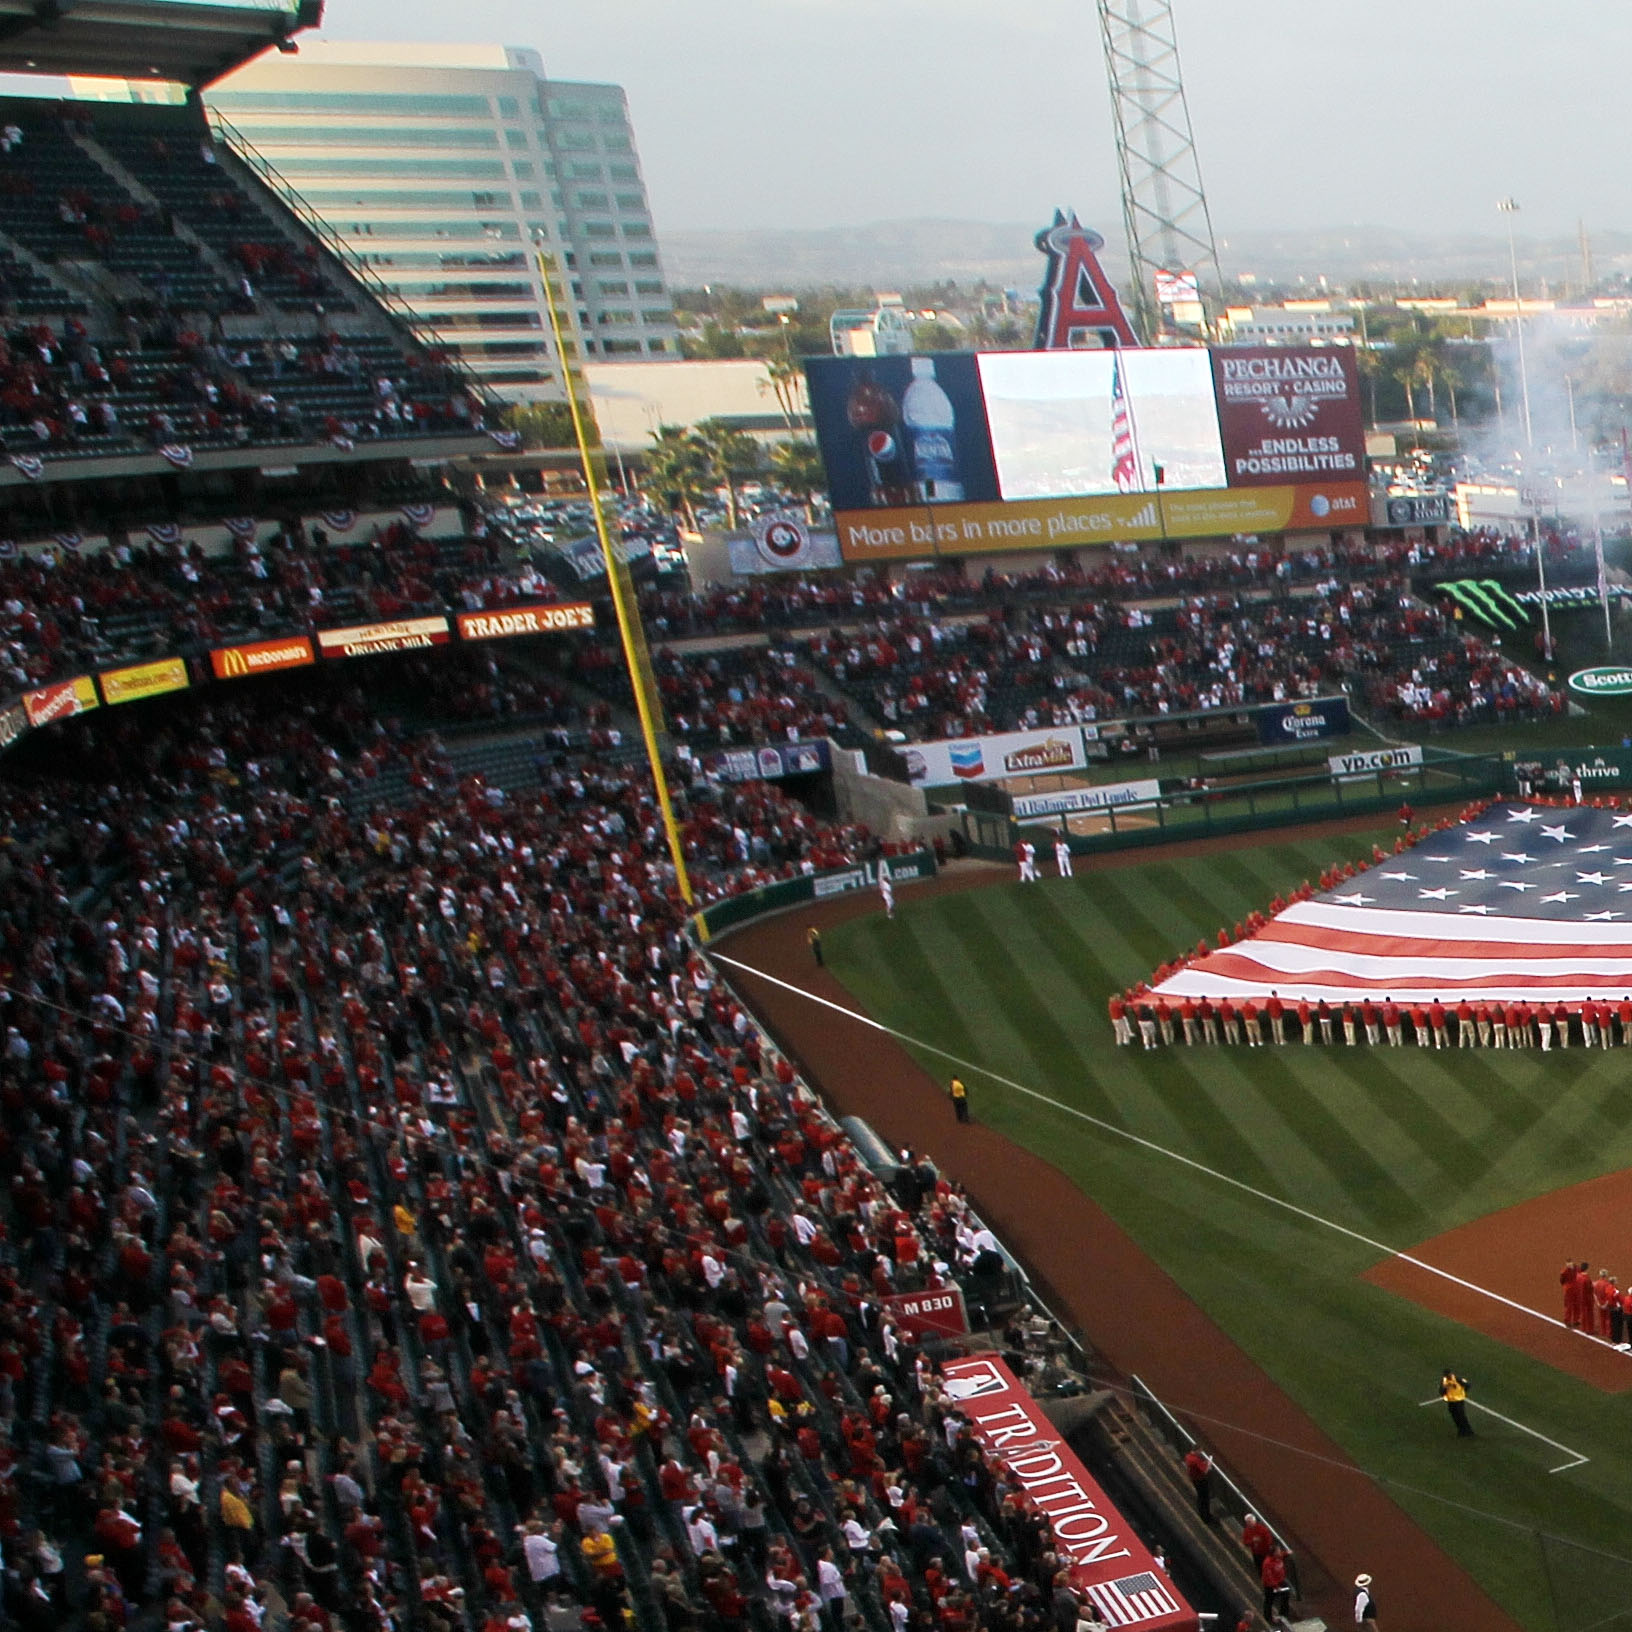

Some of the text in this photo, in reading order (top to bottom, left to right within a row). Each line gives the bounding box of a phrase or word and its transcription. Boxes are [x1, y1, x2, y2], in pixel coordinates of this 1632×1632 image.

[1221, 357, 1345, 378] PECHANGA
[1224, 380, 1346, 397] RESORT CASINO
[1235, 453, 1356, 475] POSSIBILITIES
[849, 525, 905, 547] More
[963, 517, 982, 540] in
[988, 517, 1042, 537] more
[1050, 511, 1113, 540] places
[463, 606, 594, 638] TRADER JOE'S
[1282, 715, 1326, 732] Corona
[1342, 750, 1412, 772] yp.com
[1576, 763, 1620, 778] thrive
[922, 1295, 953, 1312] 830
[976, 1402, 1131, 1568] TRADITION
